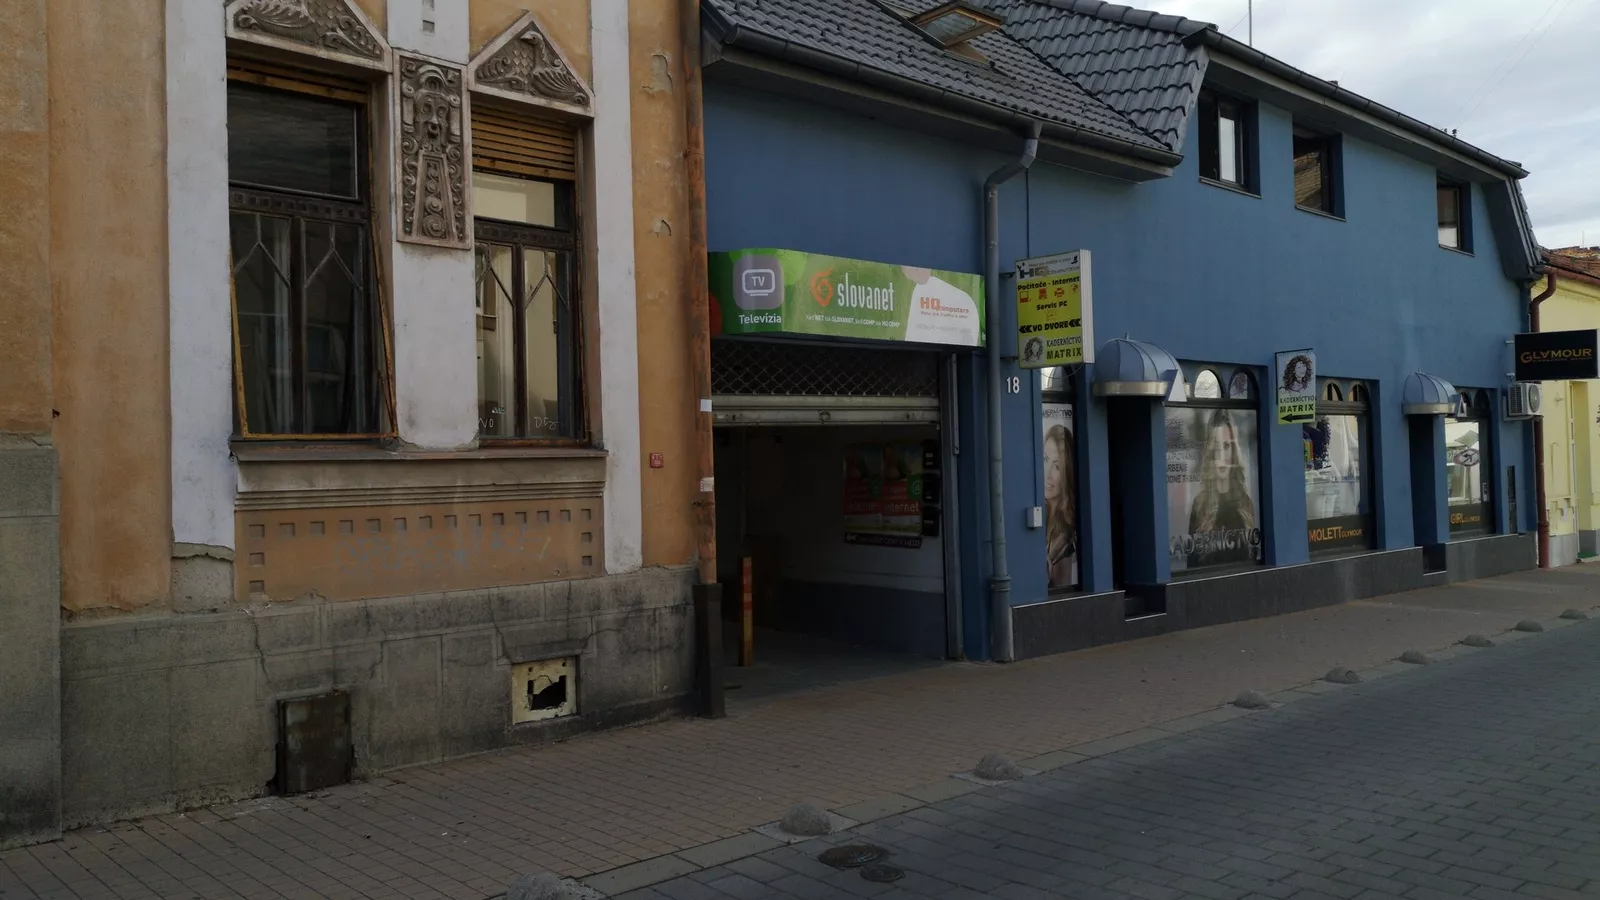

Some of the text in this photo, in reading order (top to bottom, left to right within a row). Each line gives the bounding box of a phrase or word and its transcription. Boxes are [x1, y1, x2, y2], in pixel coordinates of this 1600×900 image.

[751, 276, 765, 287] TV
[1051, 275, 1080, 286] Internet
[837, 272, 895, 312] slovanet
[1036, 300, 1068, 311] Servis PC
[738, 312, 782, 325] Televízia
[1032, 320, 1069, 333] VO DVORE
[1046, 347, 1082, 360] MATRIX
[1006, 376, 1020, 394] 18
[1280, 403, 1315, 414] MATRIX
